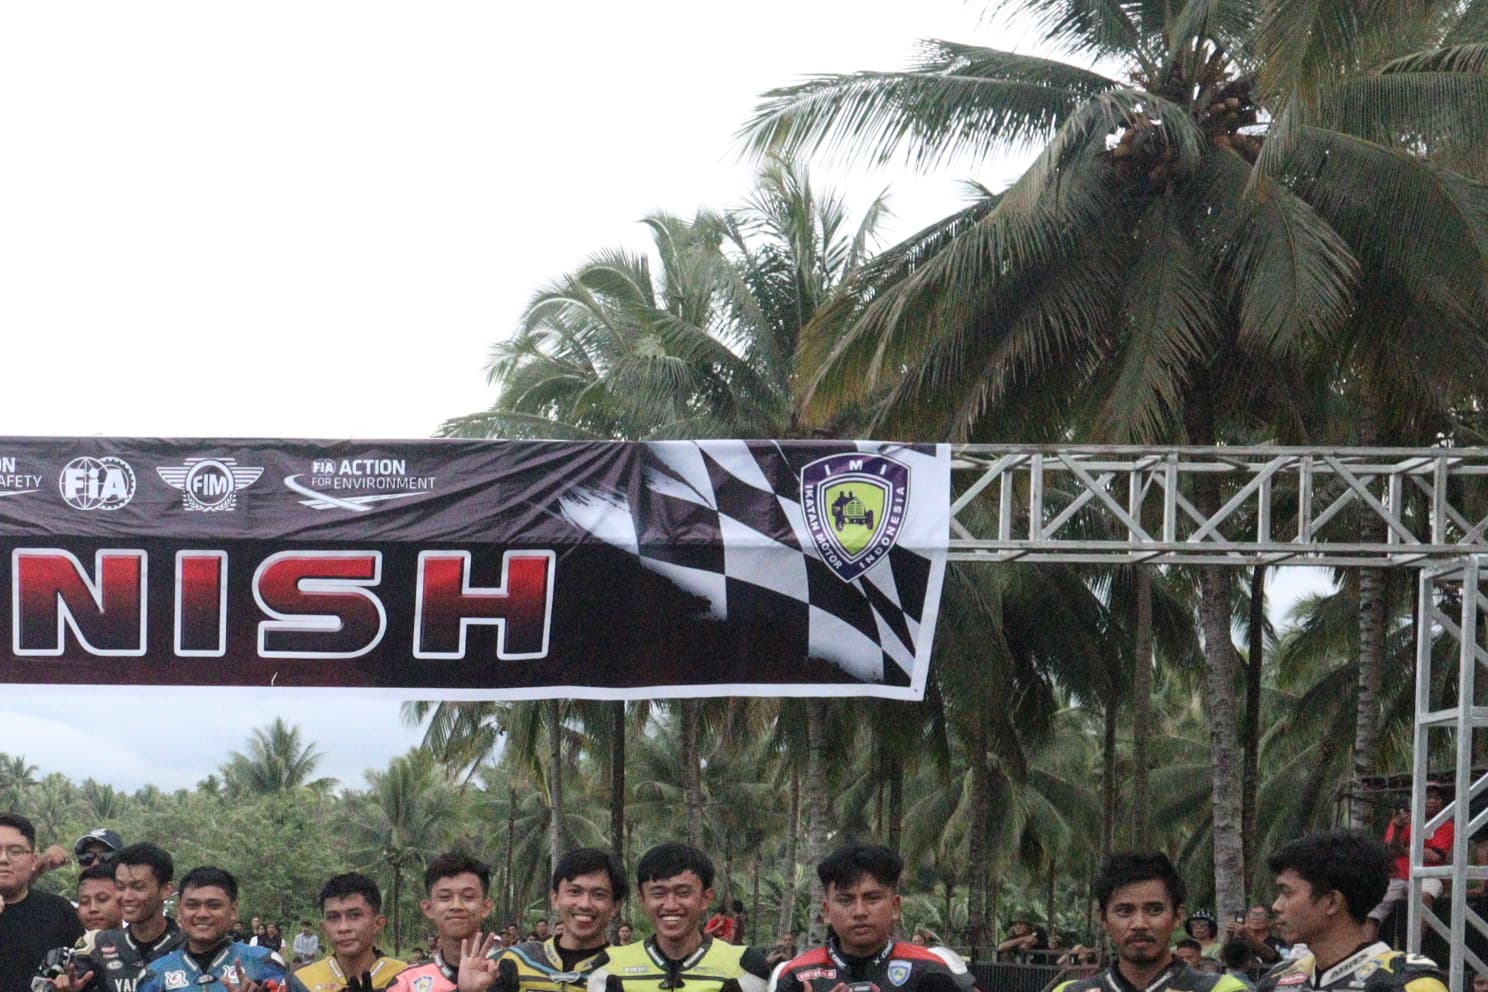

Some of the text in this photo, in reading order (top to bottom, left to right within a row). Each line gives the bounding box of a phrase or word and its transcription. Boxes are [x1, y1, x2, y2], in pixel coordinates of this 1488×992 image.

[339, 459, 405, 475] ACTION
[824, 460, 887, 476] IMI
[193, 474, 227, 496] FIM
[312, 476, 436, 489] FOR ENVIRONMENT
[804, 484, 905, 569] IKATAN MOTOR INDONESIA
